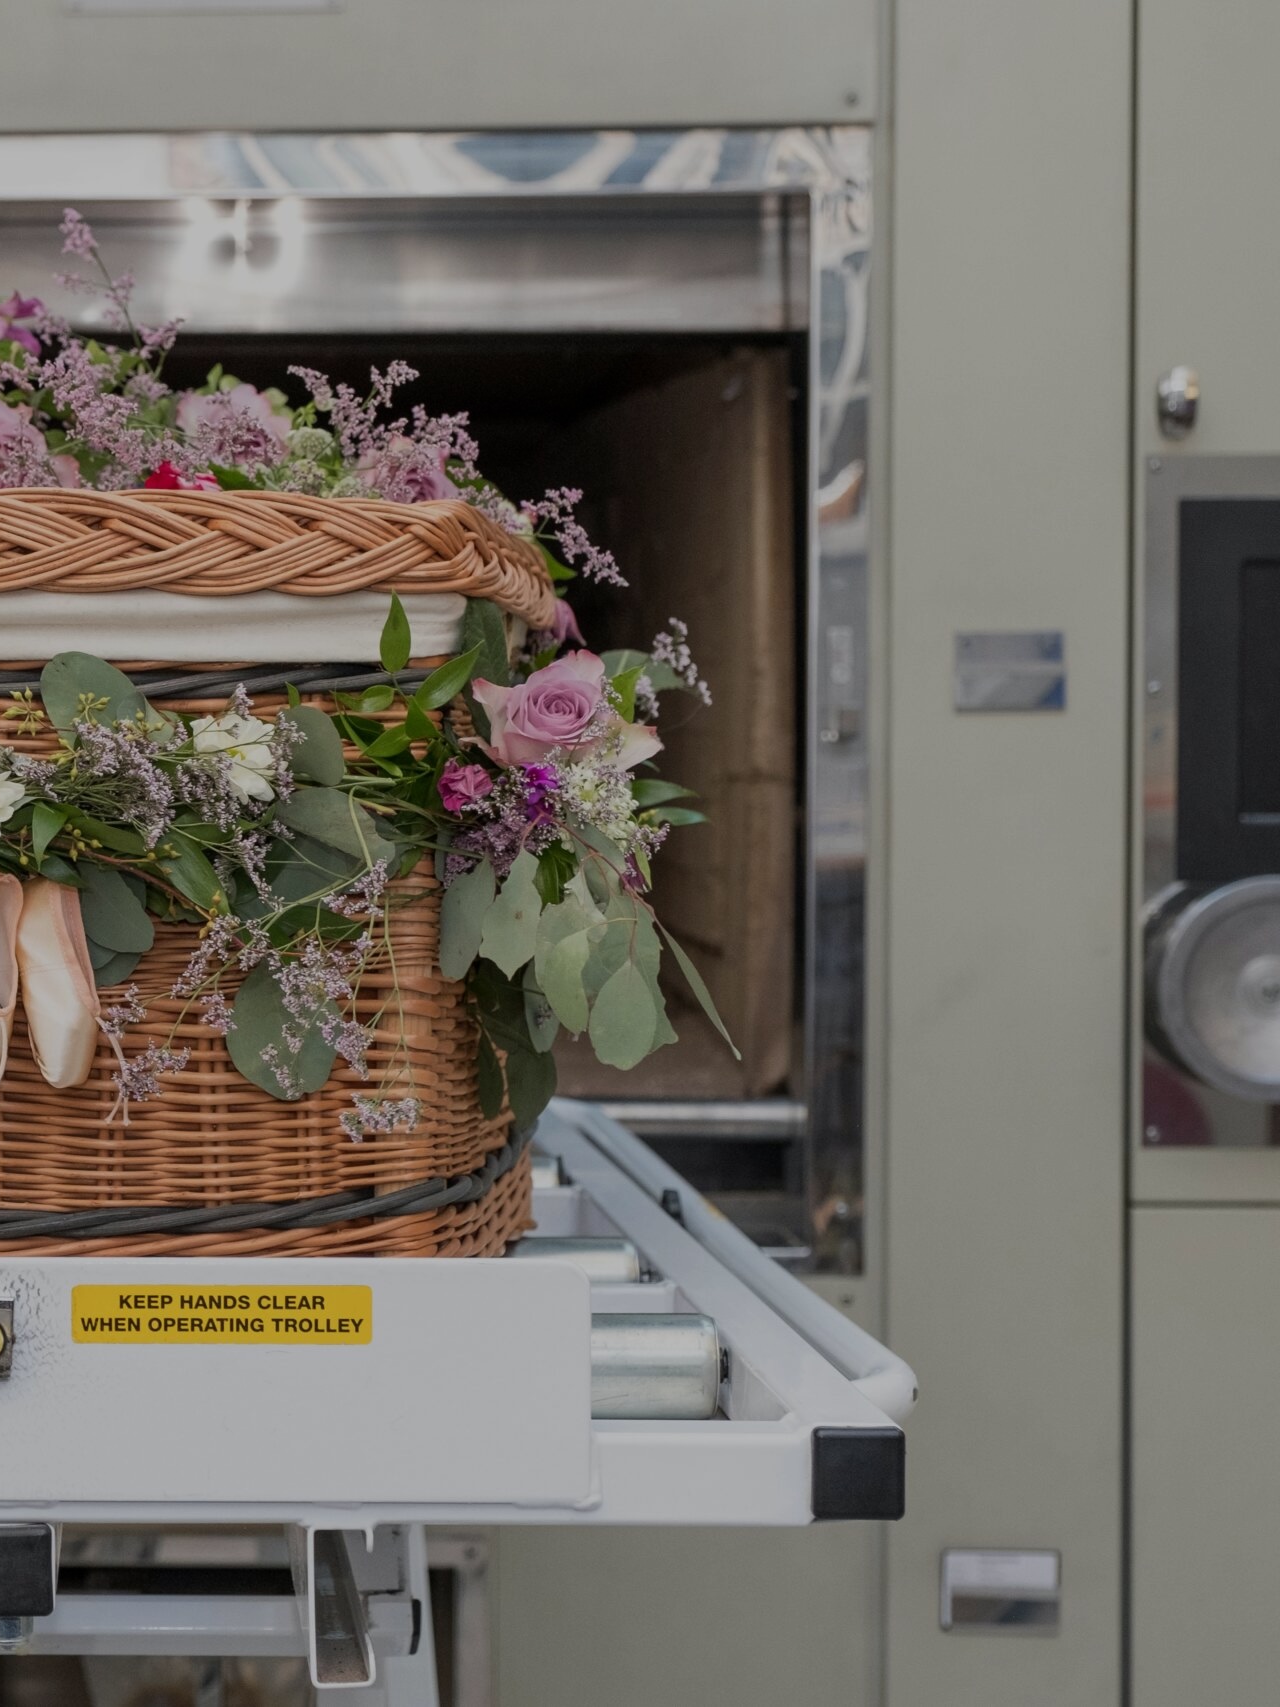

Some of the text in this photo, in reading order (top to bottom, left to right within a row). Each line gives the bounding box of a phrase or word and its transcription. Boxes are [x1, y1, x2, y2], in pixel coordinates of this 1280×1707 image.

[119, 1295, 325, 1310] KEEP HANDS CLEAR
[80, 1317, 364, 1333] WHEN OPERATING TROLLEY
